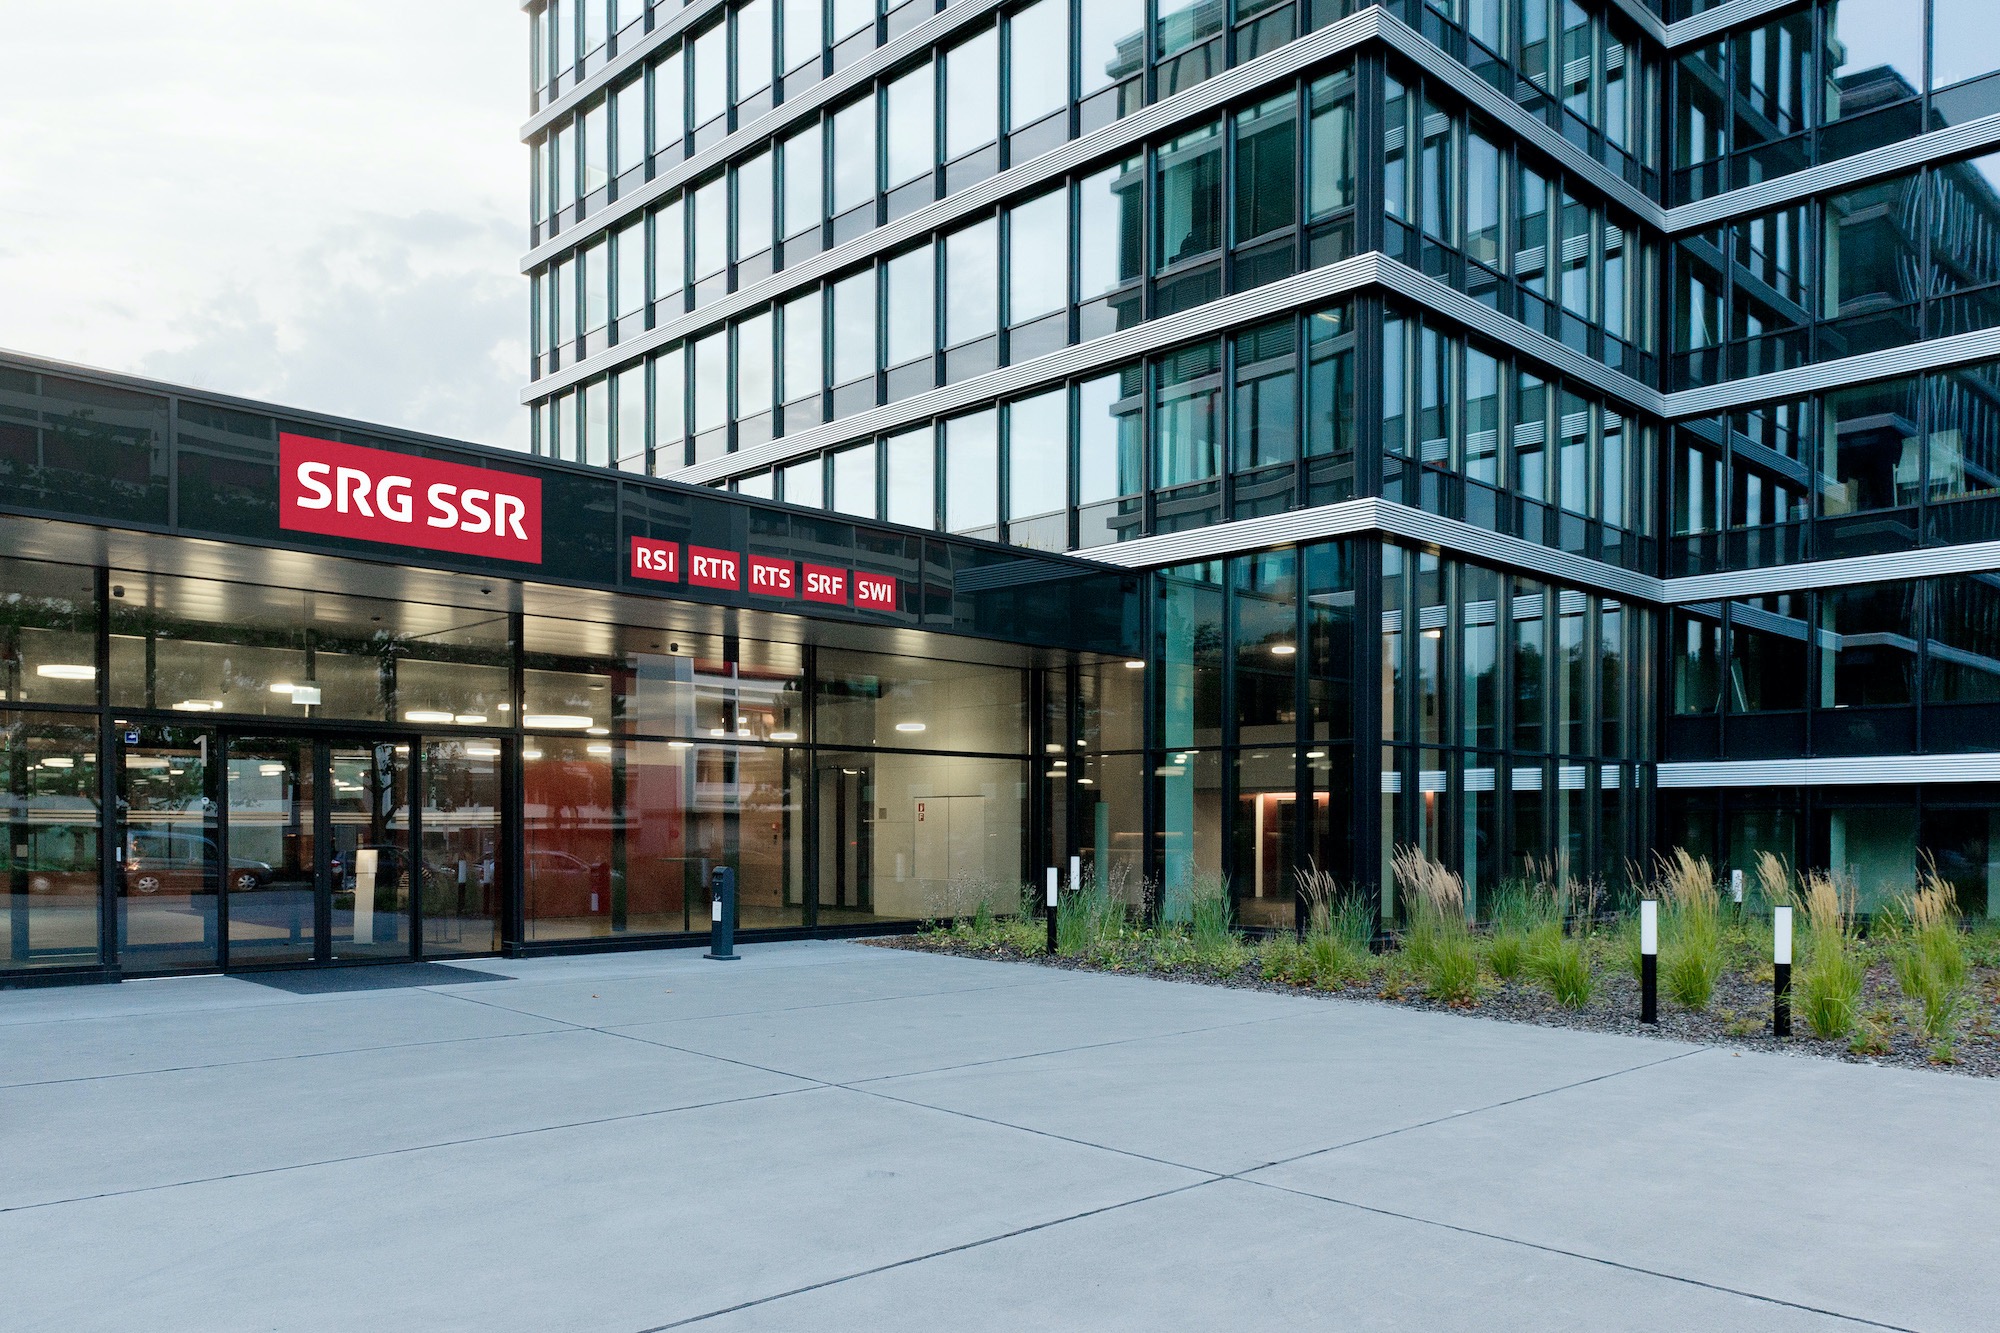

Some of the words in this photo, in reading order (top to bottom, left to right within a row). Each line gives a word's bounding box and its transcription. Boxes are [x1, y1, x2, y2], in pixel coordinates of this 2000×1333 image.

[296, 461, 413, 523] SRG
[427, 483, 528, 541] SSR
[636, 546, 674, 573] RSI
[693, 555, 736, 582] RTR
[753, 564, 791, 589] RTS
[807, 572, 843, 596] SRF
[858, 580, 892, 603] SWI
[193, 735, 207, 767] 1
